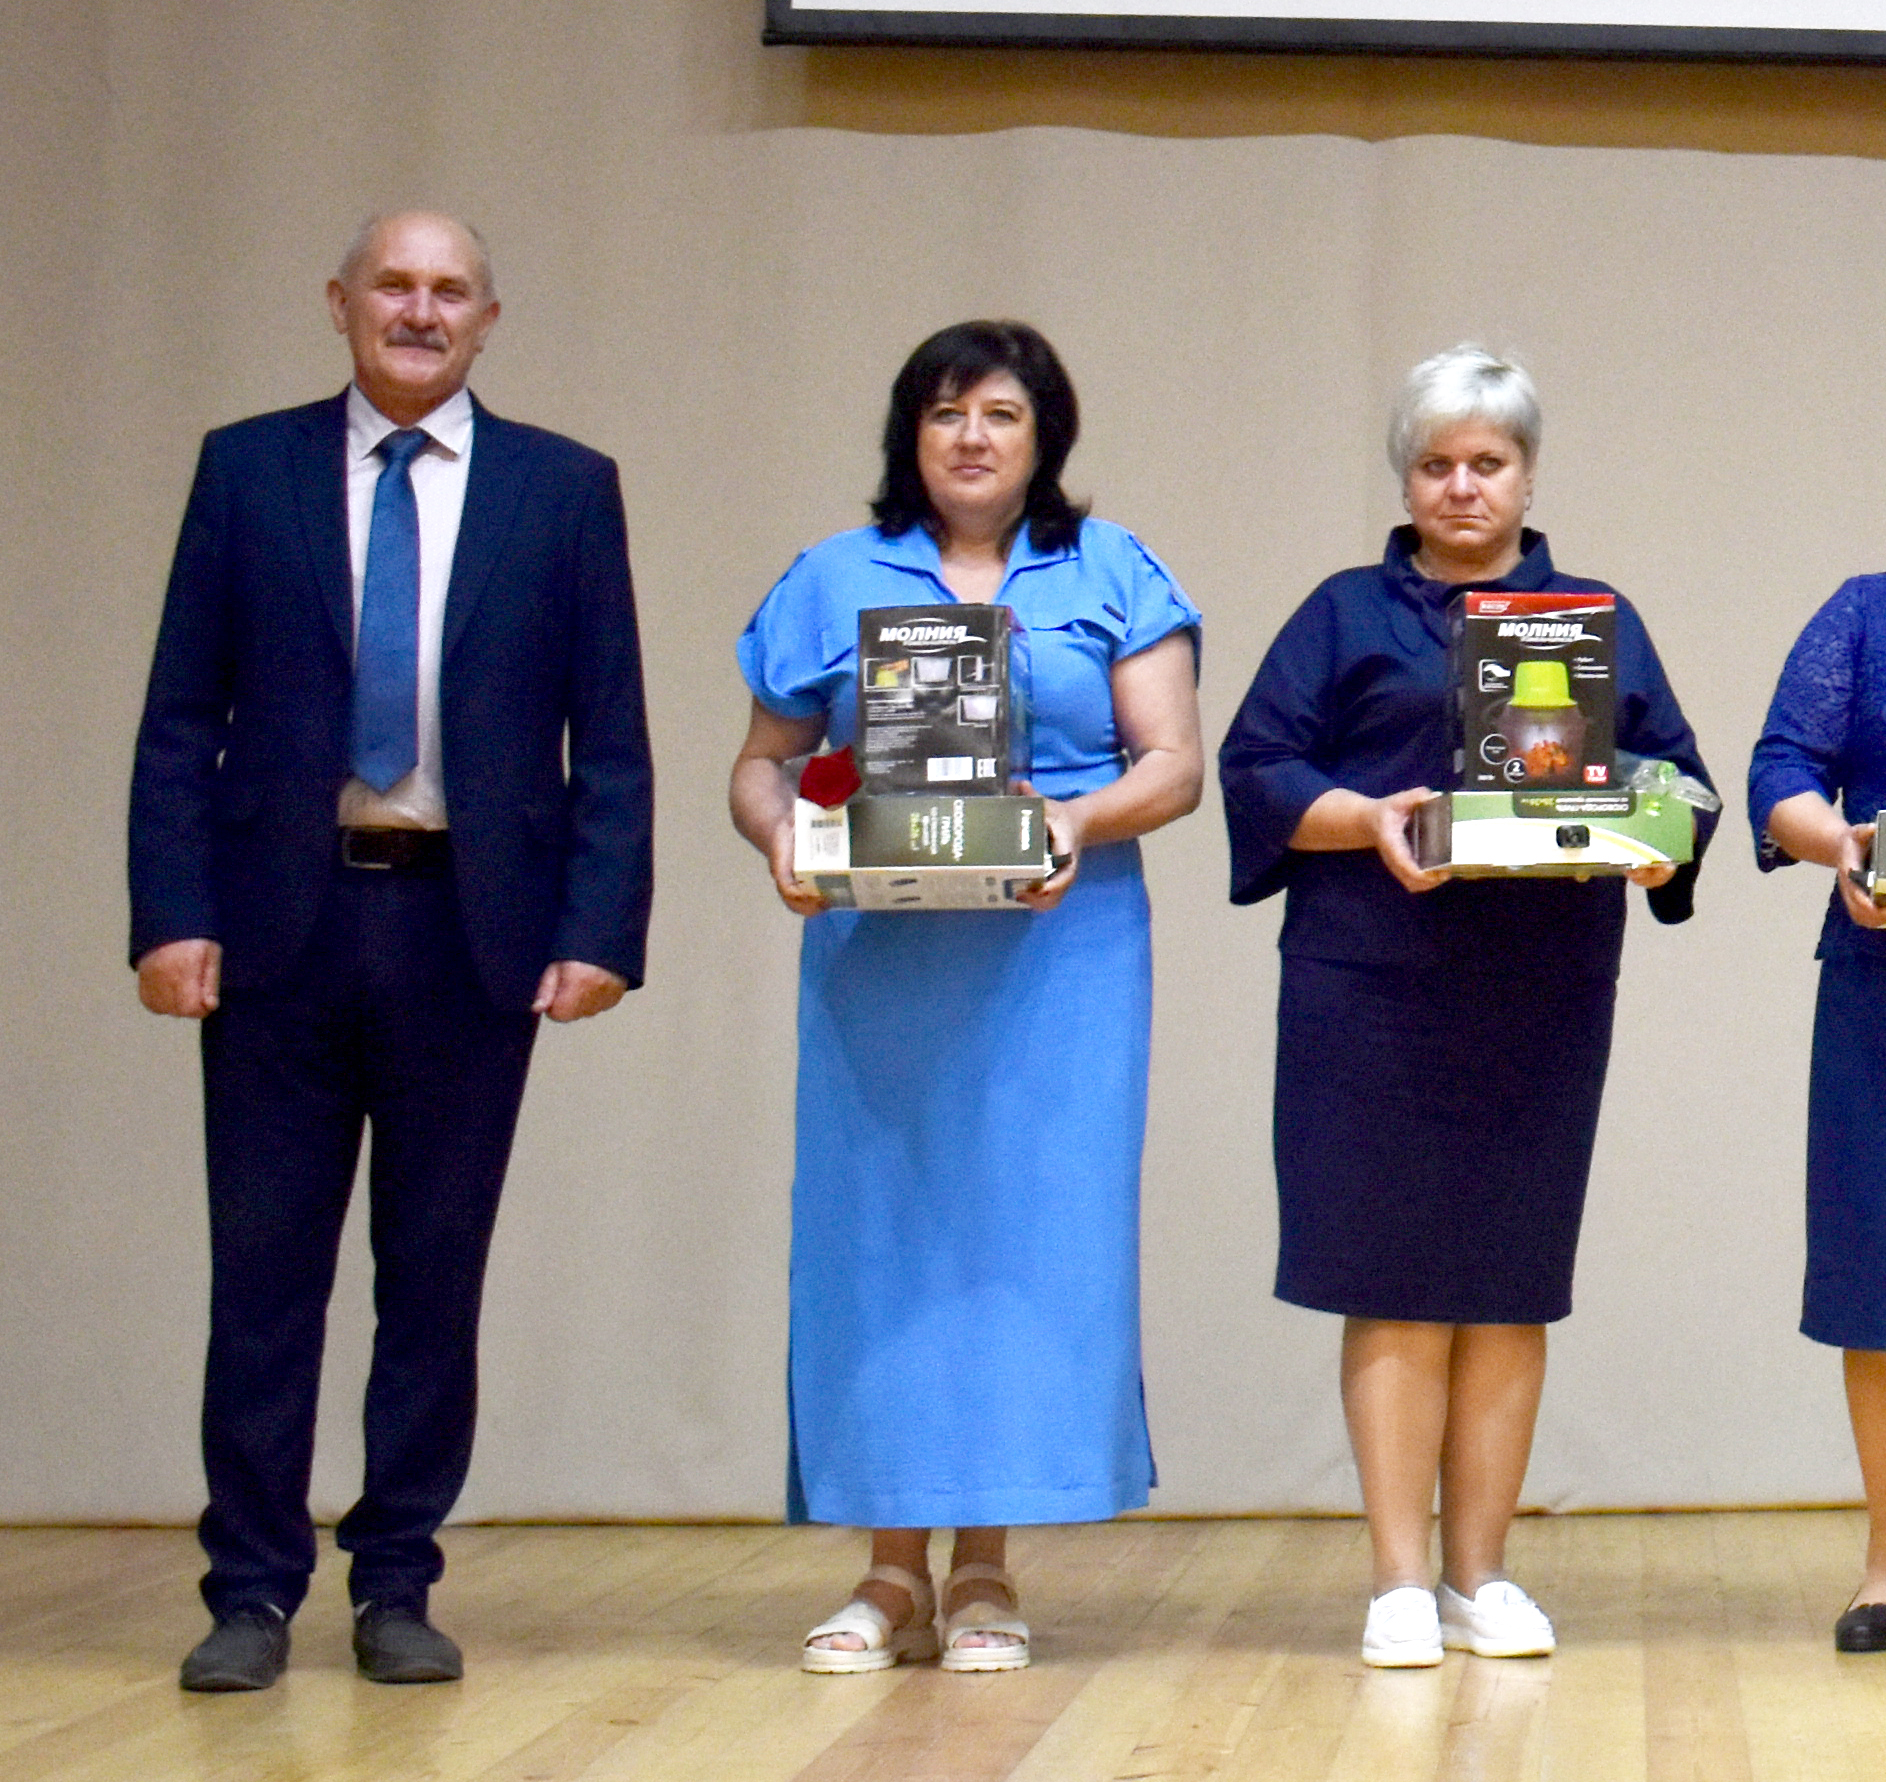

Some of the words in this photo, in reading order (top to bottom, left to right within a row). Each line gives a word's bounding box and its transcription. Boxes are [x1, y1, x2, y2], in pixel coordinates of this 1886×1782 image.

[879, 625, 970, 643] МОЛНИЯ
[1497, 622, 1585, 638] МОЛНИЯ
[1512, 762, 1520, 772] 2
[1587, 765, 1607, 777] TV
